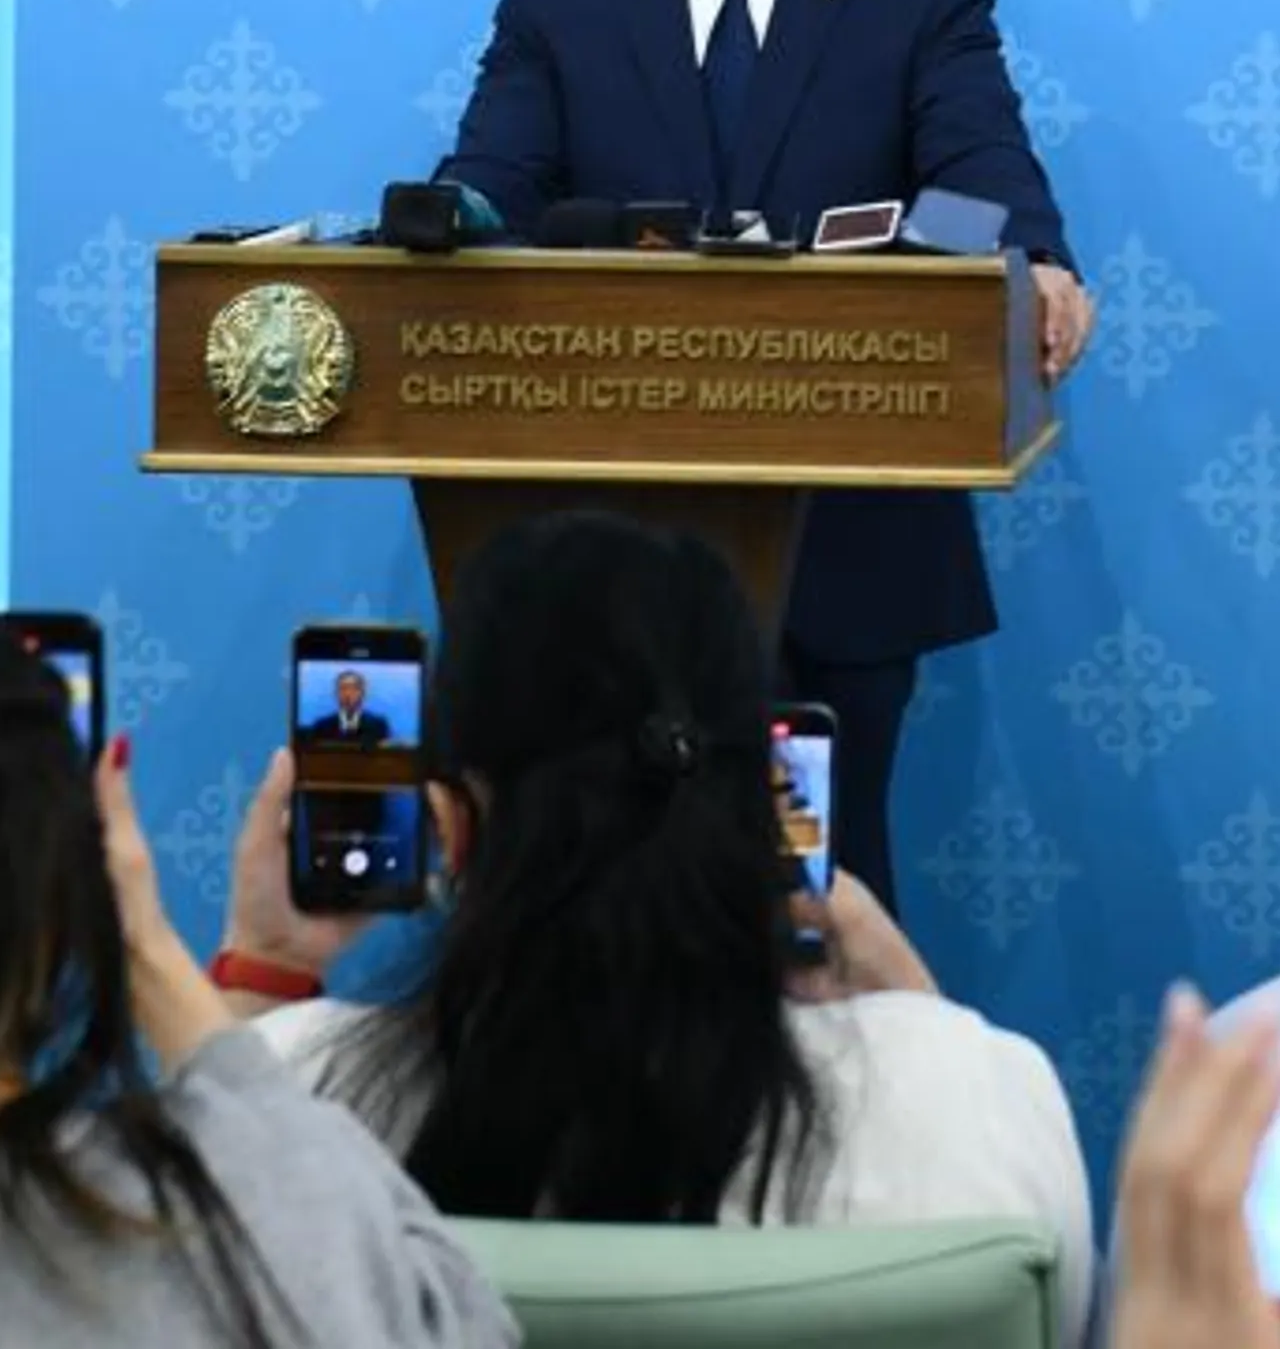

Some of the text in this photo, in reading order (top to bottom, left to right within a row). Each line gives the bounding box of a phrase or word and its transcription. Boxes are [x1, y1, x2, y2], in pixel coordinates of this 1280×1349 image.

[400, 321, 950, 363] ҚАЗАҚСТАН РЕСПУБЛИКАСЫ
[400, 373, 568, 410] СЫРТҚЫ
[582, 376, 688, 410] ІСТЕР
